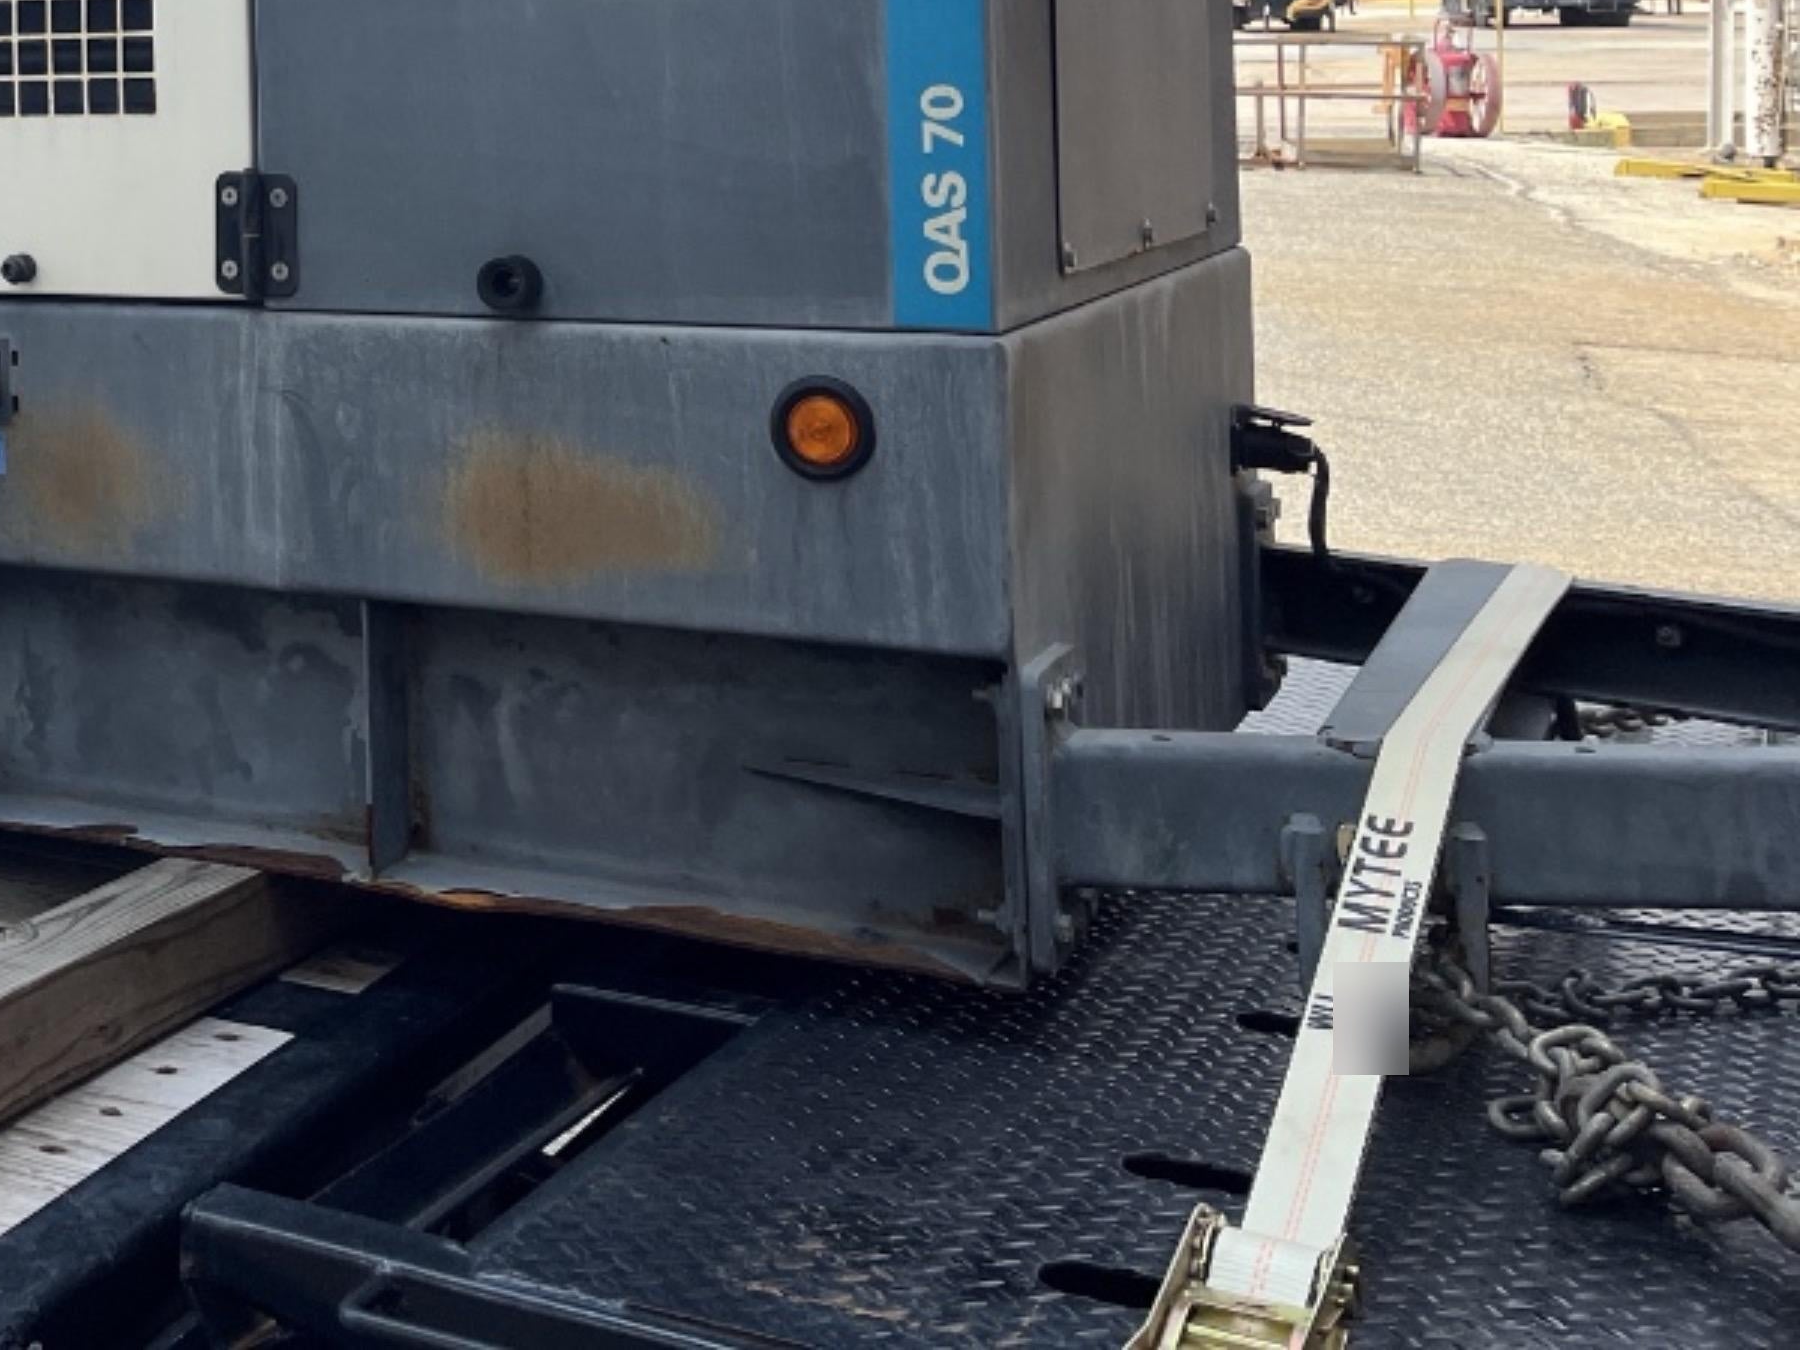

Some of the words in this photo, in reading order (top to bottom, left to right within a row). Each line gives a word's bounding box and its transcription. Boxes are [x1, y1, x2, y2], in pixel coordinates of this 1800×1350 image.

[920, 83, 964, 154] 70
[920, 170, 970, 295] QAS
[1337, 814, 1414, 934] MYTEE
